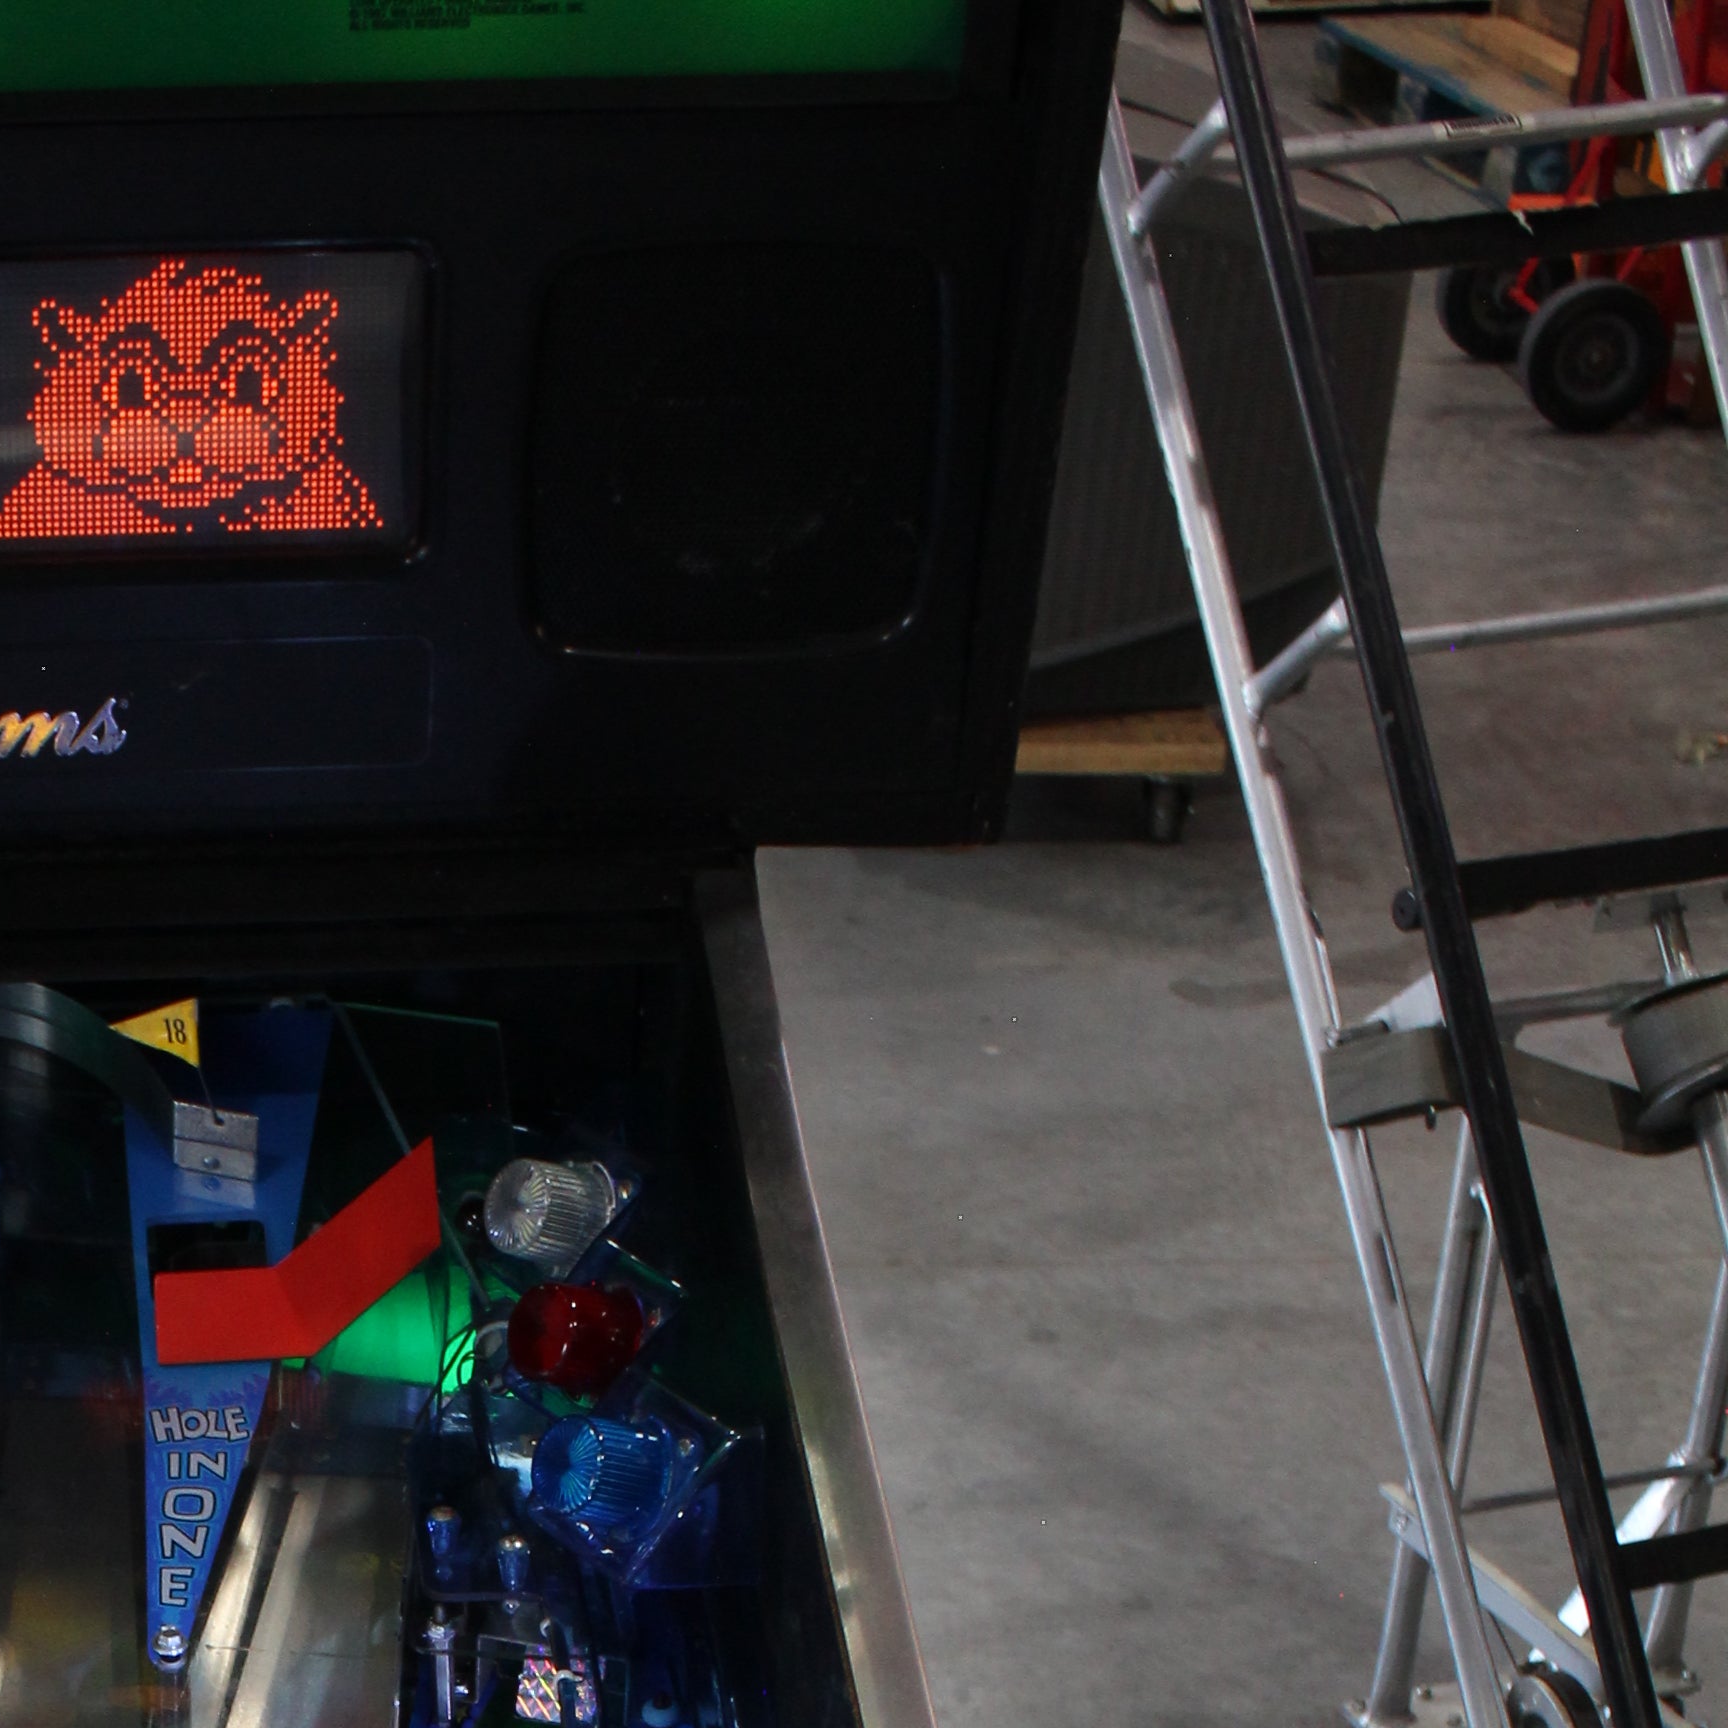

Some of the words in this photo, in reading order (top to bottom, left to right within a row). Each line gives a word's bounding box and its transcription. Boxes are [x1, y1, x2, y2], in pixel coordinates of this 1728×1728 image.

[162, 1017, 187, 1044] 18
[150, 1405, 250, 1443] HOLE
[167, 1452, 227, 1480] IN
[160, 1487, 217, 1608] ONE
